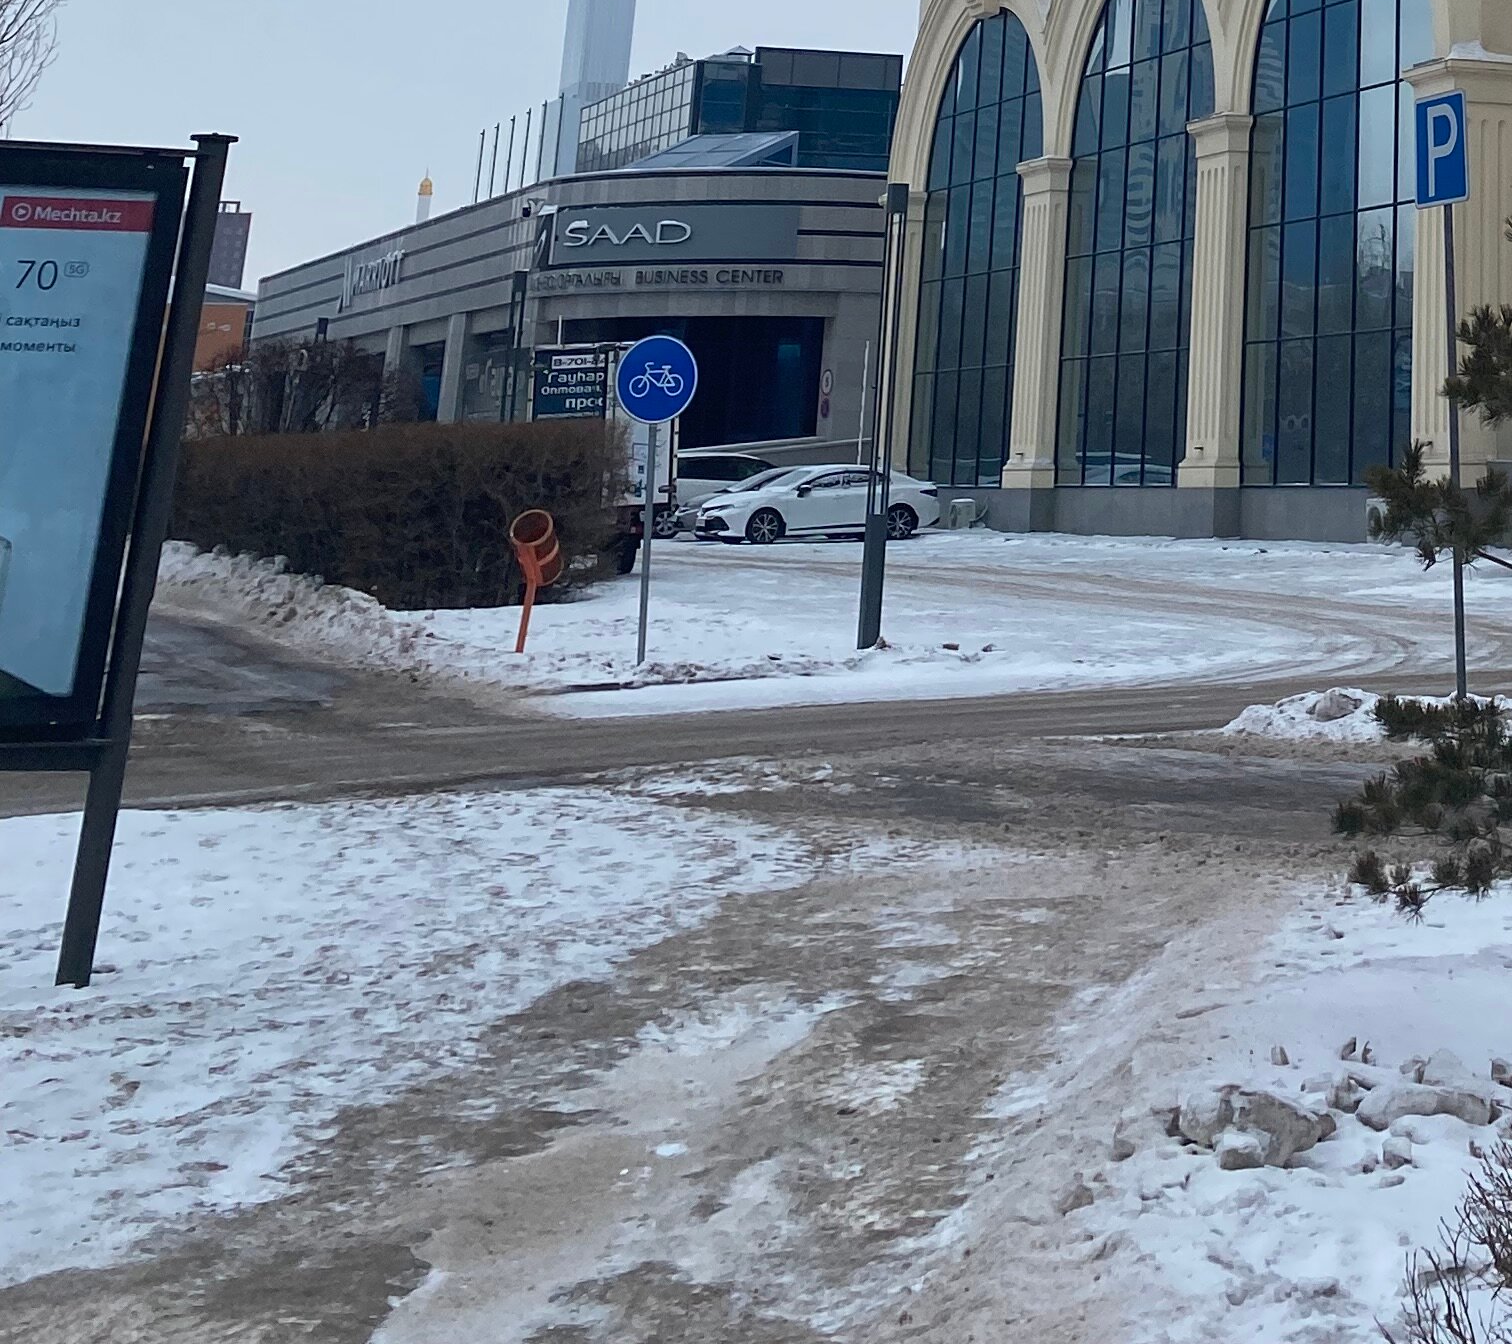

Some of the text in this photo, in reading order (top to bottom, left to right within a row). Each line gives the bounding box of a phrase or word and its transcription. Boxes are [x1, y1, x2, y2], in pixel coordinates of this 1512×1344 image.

[1426, 103, 1458, 198] P
[34, 206, 122, 224] Mechta.kz
[563, 219, 692, 247] SAAD
[15, 260, 85, 291] 70 5G
[635, 269, 784, 285] BUSINESS CENTER
[0, 342, 76, 352] моменты
